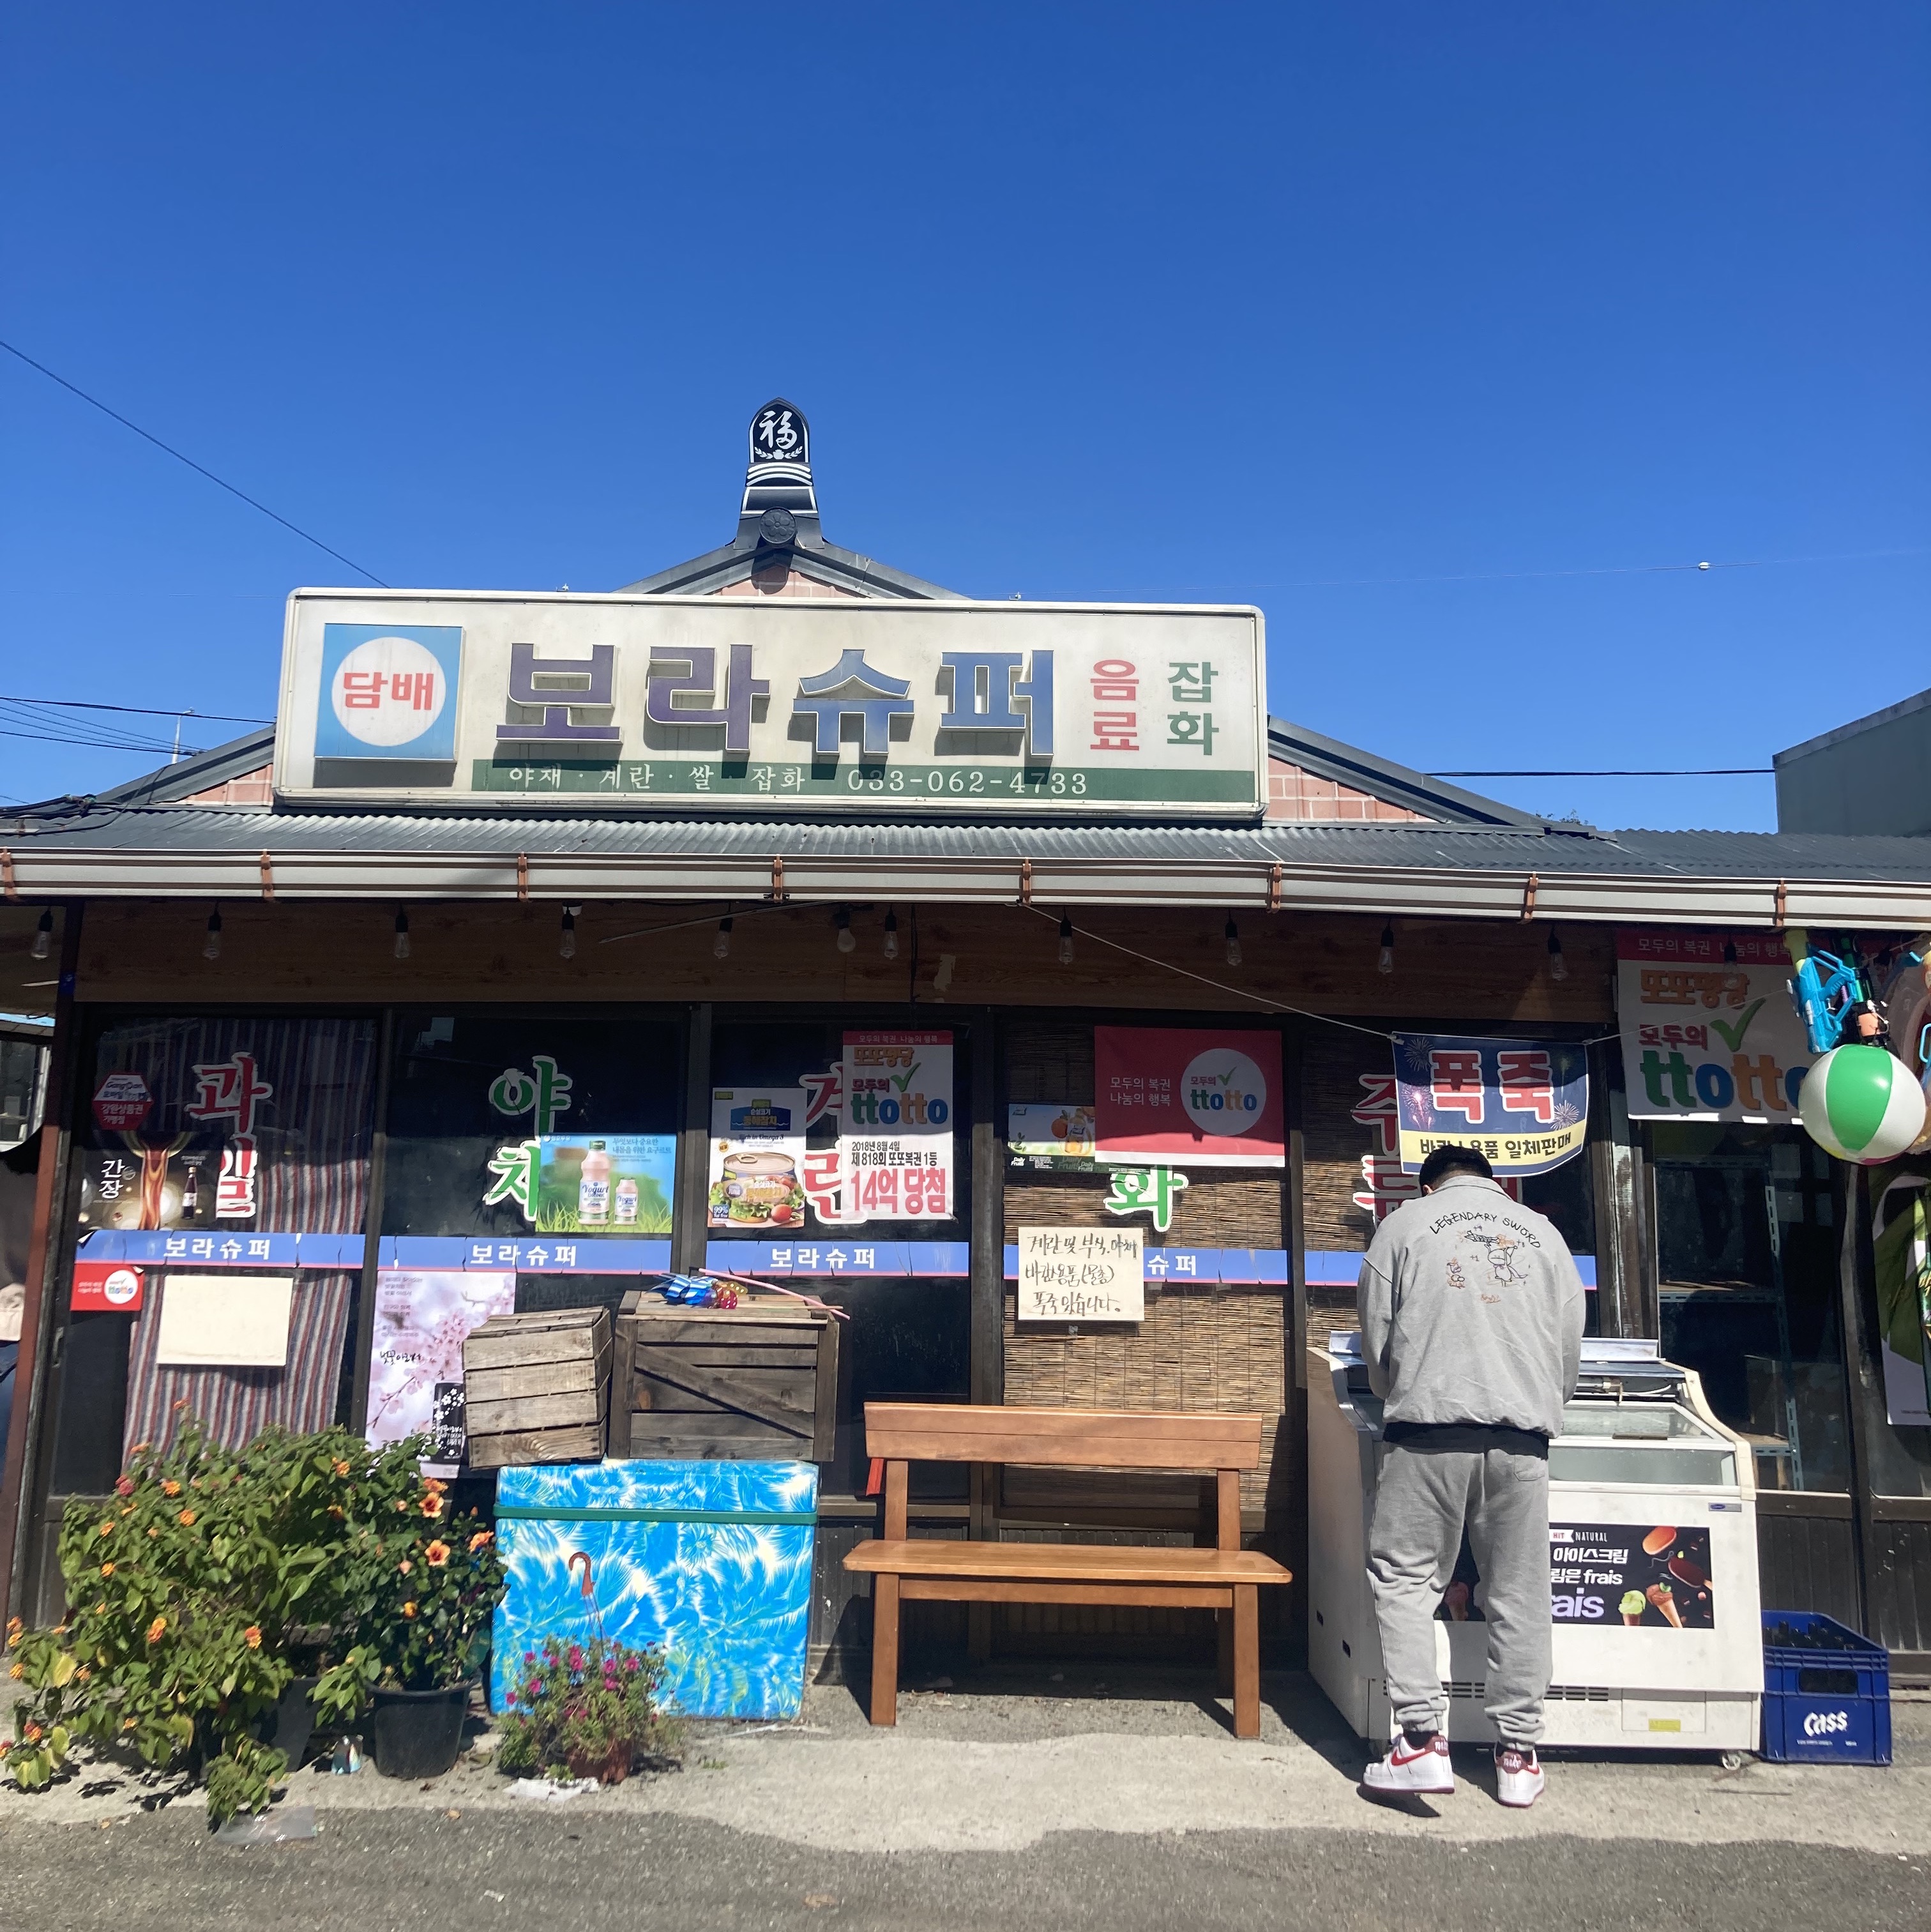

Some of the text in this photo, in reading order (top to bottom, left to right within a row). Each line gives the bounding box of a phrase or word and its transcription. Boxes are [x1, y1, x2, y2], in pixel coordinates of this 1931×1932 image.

[759, 411, 798, 449] 福
[343, 672, 433, 711] 담배
[496, 643, 1054, 756] 보라슈퍼
[1089, 658, 1140, 751] 음료
[1167, 662, 1219, 756] 잡화
[599, 764, 655, 790] 계란
[688, 764, 715, 791] 쌀
[750, 766, 805, 792] 잡화
[847, 770, 1087, 795] 033-062-4733
[1638, 938, 1679, 954] 모두의
[1683, 940, 1711, 956] 복권
[1639, 1023, 1708, 1051] 모두의
[851, 1078, 890, 1093] 모두의
[1110, 1077, 1171, 1092] 모두의 복권
[1190, 1076, 1216, 1086] 모두의
[1428, 1050, 1555, 1124] 폭죽
[851, 1093, 948, 1125] ttotto
[1110, 1092, 1172, 1107] 나눔의 행복
[1190, 1089, 1257, 1111] ttotto
[852, 1141, 900, 1152] 2018년 8월 4일
[1505, 1132, 1571, 1159] 일체판매
[851, 1152, 937, 1166] 제 818회 또또복권 1등
[99, 1159, 126, 1199] 간장
[582, 1185, 609, 1195] Yogurt
[851, 1168, 946, 1215] 14억 당첨
[1430, 1212, 1541, 1248] LEGENDARY SWORD
[163, 1237, 271, 1261] 보라슈퍼
[470, 1244, 577, 1266] 보라슈퍼
[769, 1247, 875, 1270] 보라슈퍼
[1033, 1291, 1058, 1316] 폭죽
[1575, 1532, 1608, 1542] NATURAL
[1553, 1547, 1629, 1564] 아이스크림
[1583, 1569, 1623, 1585] frais
